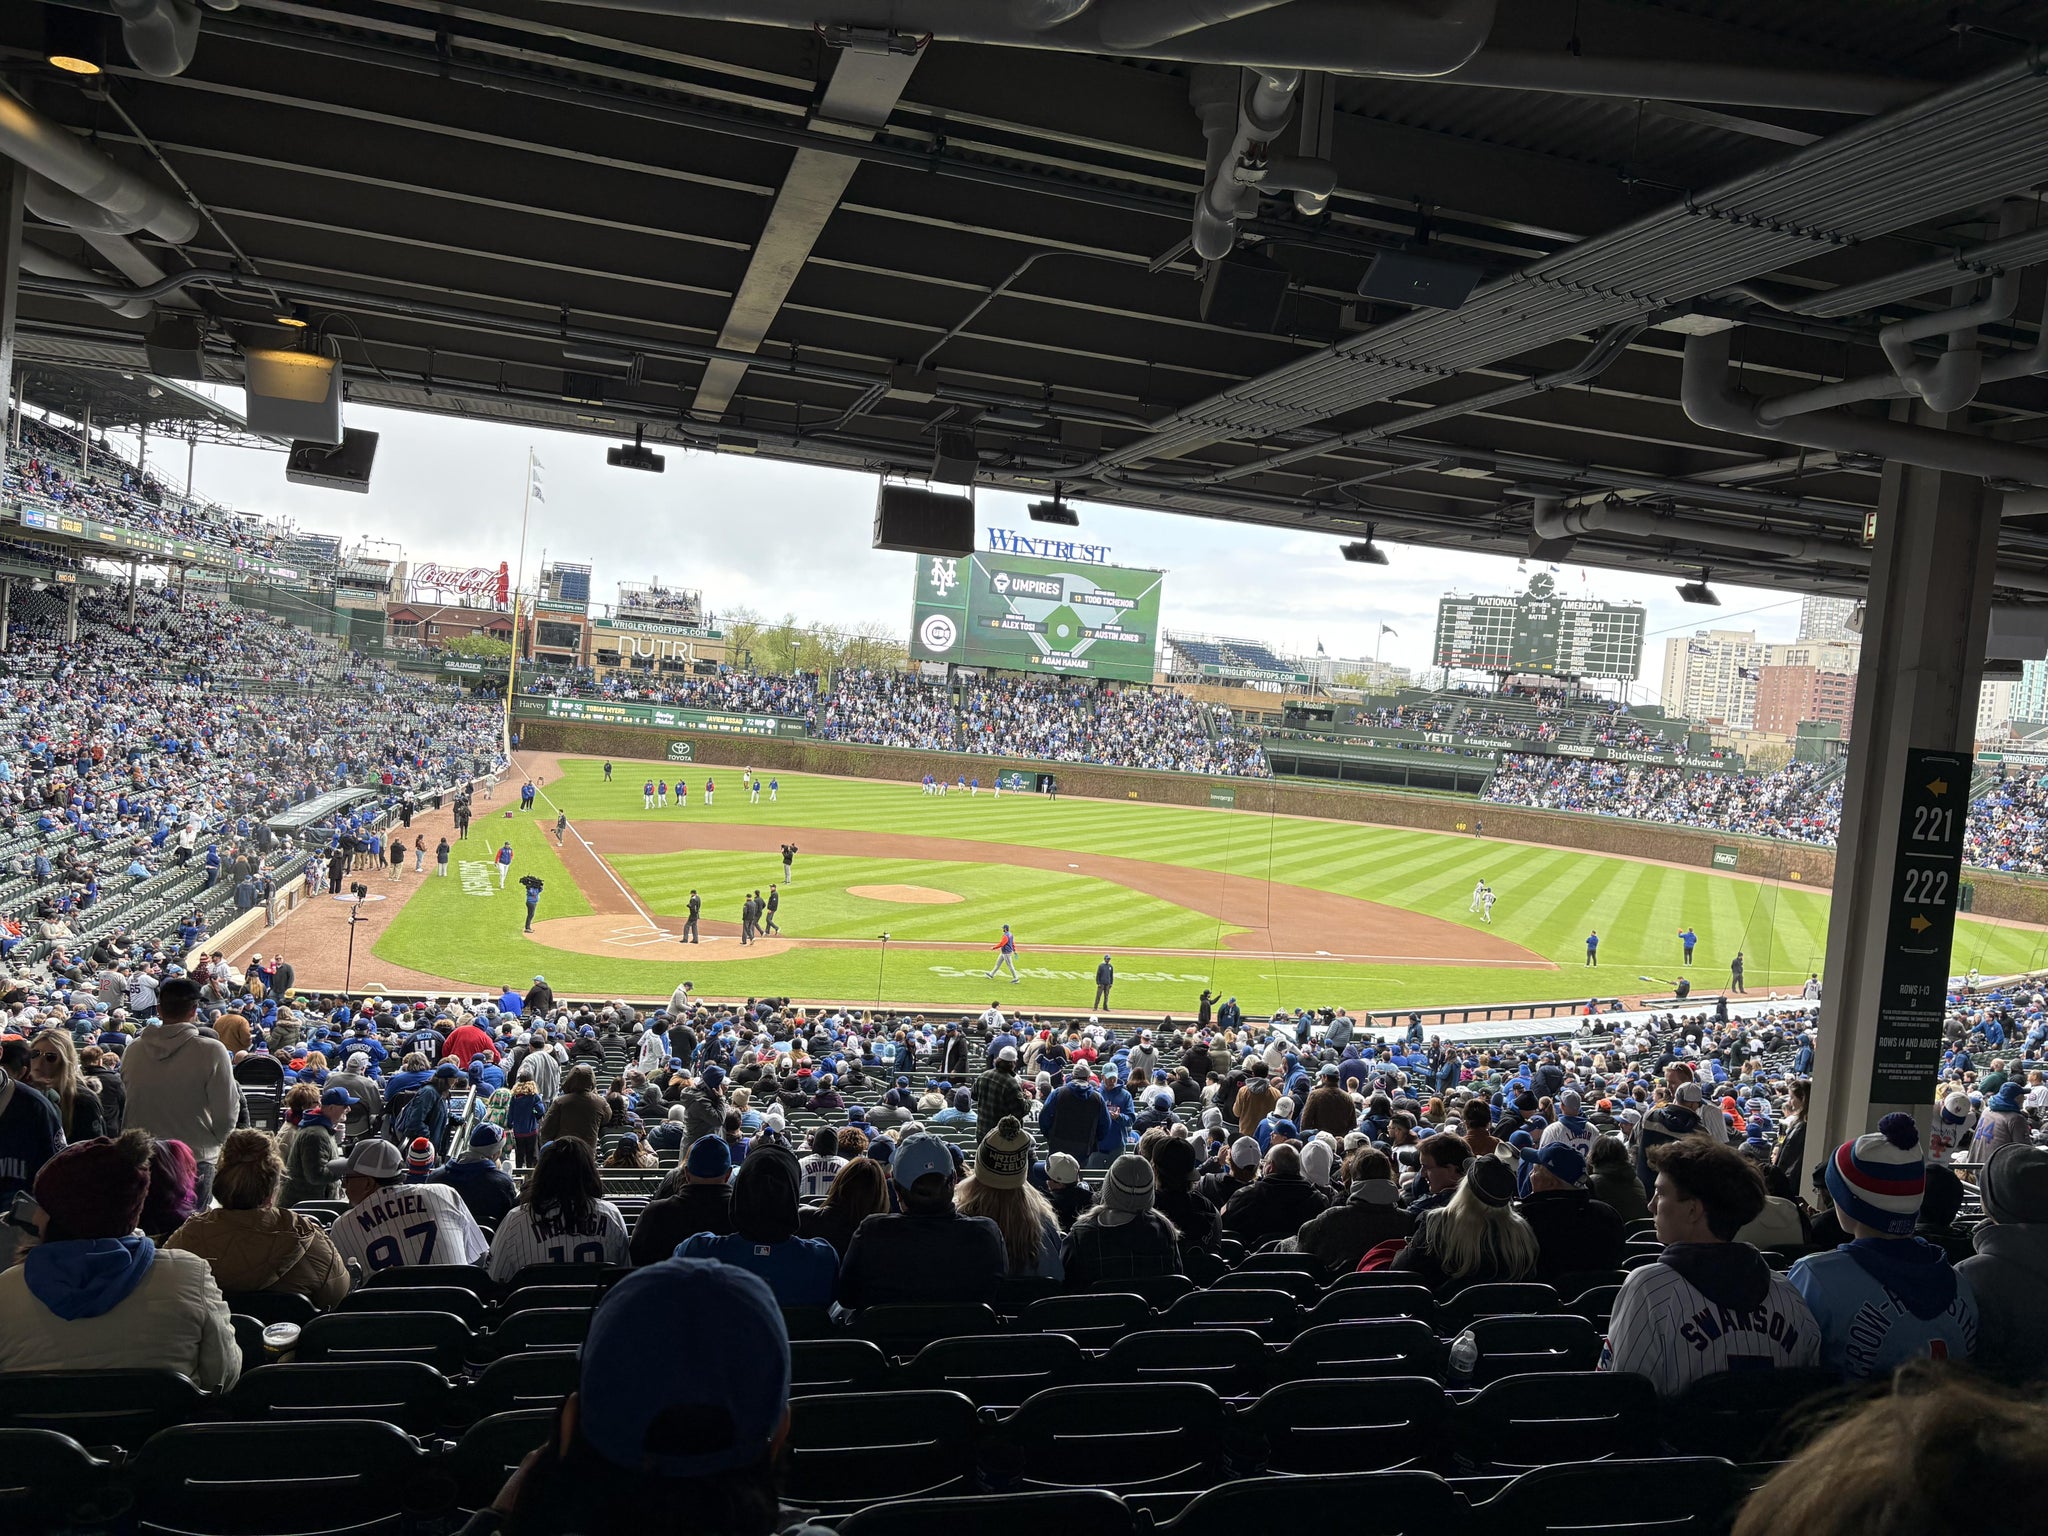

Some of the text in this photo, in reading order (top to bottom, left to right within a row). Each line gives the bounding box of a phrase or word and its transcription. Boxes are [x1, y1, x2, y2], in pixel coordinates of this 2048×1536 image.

[987, 528, 1112, 563] WINTRUST
[411, 562, 504, 597] Coca-Cola
[1012, 578, 1060, 595] UMPIRES
[1477, 597, 1519, 607] NATIONAL
[1560, 601, 1605, 611] AMERICAN
[611, 620, 709, 638] WRIGLEYROOFTOPS.COM
[1002, 621, 1019, 629] ALEX
[1020, 622, 1036, 631] TOSI
[1094, 630, 1117, 640] AUSTIN
[444, 660, 482, 670] GRAINGER
[1042, 656, 1060, 666] ADAM
[1218, 666, 1296, 681] WRIGLEYROOFTOPS.COM
[519, 700, 546, 710] Harvey
[1423, 732, 1453, 744] YETI
[1470, 738, 1512, 749] tastytrade
[1557, 744, 1596, 753] GRAINGER
[668, 754, 692, 762] TOYOTA
[1685, 757, 1724, 768] Advocate
[1912, 806, 1953, 842] 221
[1904, 868, 1949, 905] 222
[1900, 984, 1918, 995] ROWS
[1092, 1028, 1103, 1037] 22
[413, 1039, 436, 1058] 44
[1878, 1037, 1898, 1047] ROWS
[1905, 1038, 1918, 1048] AND
[1919, 1038, 1939, 1049] ABOVE
[805, 1161, 841, 1175] BRYANT
[356, 1194, 427, 1233] MACIEL
[366, 1220, 438, 1271] 97
[1680, 1304, 1799, 1355] SWANSON
